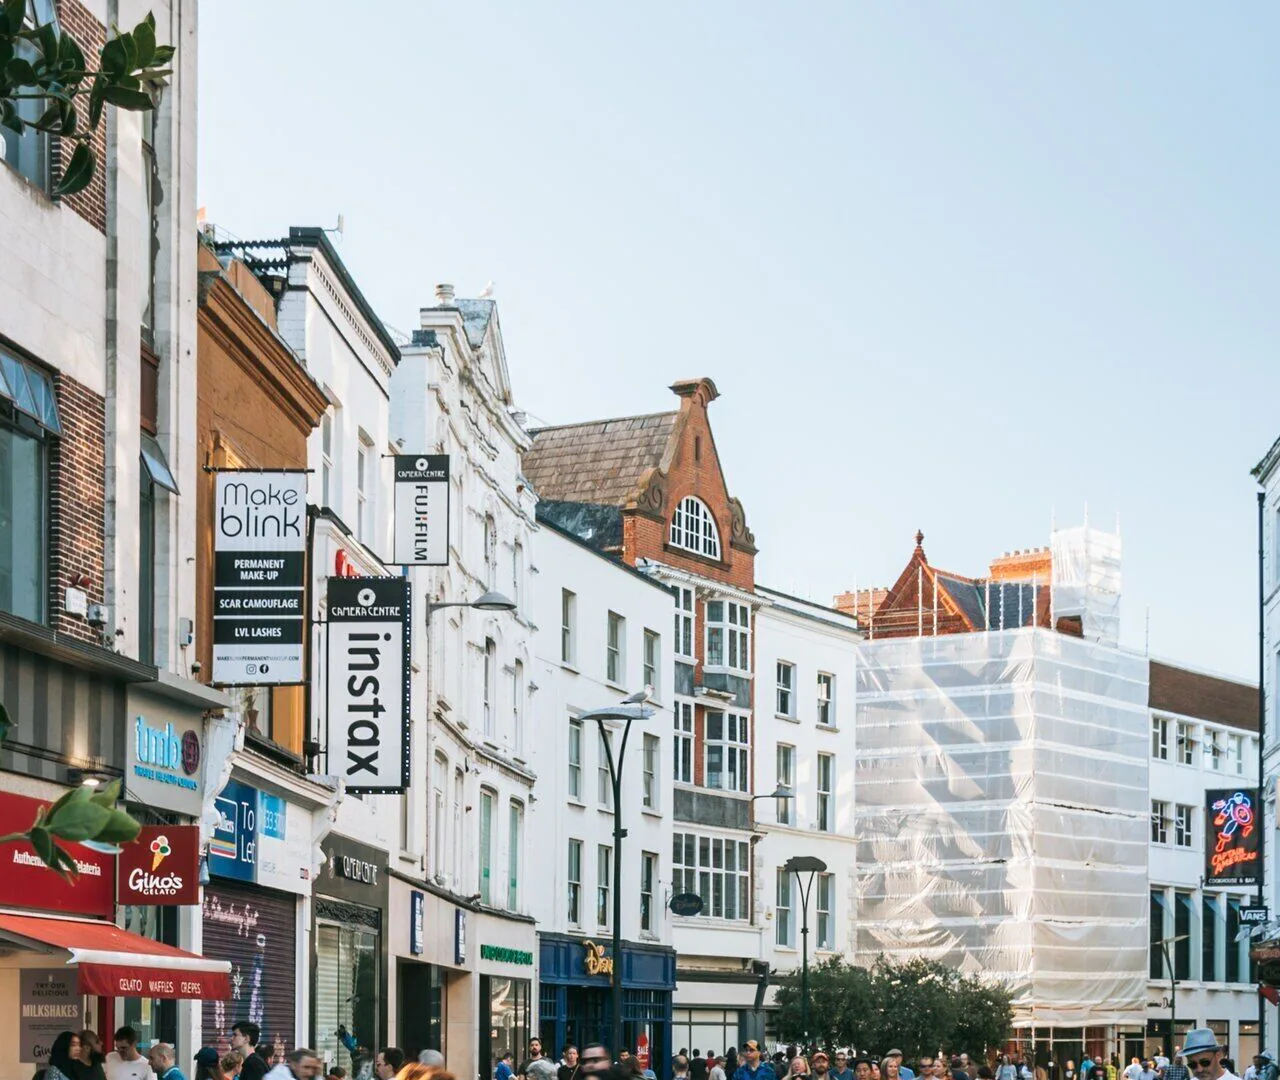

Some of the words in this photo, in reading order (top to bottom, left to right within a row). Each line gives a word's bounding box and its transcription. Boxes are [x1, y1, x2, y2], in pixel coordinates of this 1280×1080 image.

[398, 470, 422, 478] CAMERA
[423, 470, 445, 478] CENTRE
[224, 483, 298, 505] Make
[221, 506, 300, 537] blink
[414, 485, 428, 561] FUJIFILM
[234, 559, 285, 569] PERMANENT
[240, 570, 279, 580] MAKE-UP
[220, 598, 241, 609] SCAR
[242, 598, 299, 609] CAMOUFLAGE
[332, 607, 367, 616] CAMERA
[368, 607, 401, 616] CENTRE
[234, 627, 250, 637] LVL
[251, 627, 282, 637] LASHES
[346, 632, 392, 777] instax
[135, 714, 180, 770] tmb
[241, 801, 255, 831] To
[241, 835, 255, 864] Let
[128, 868, 183, 893] Gino's
[142, 888, 177, 896] GELATO
[1240, 909, 1266, 921] VANS
[120, 978, 143, 992] GELATO
[148, 980, 174, 993] WAFFLES
[180, 982, 201, 995] CREPES
[22, 1004, 79, 1018] MILKSHAKES
